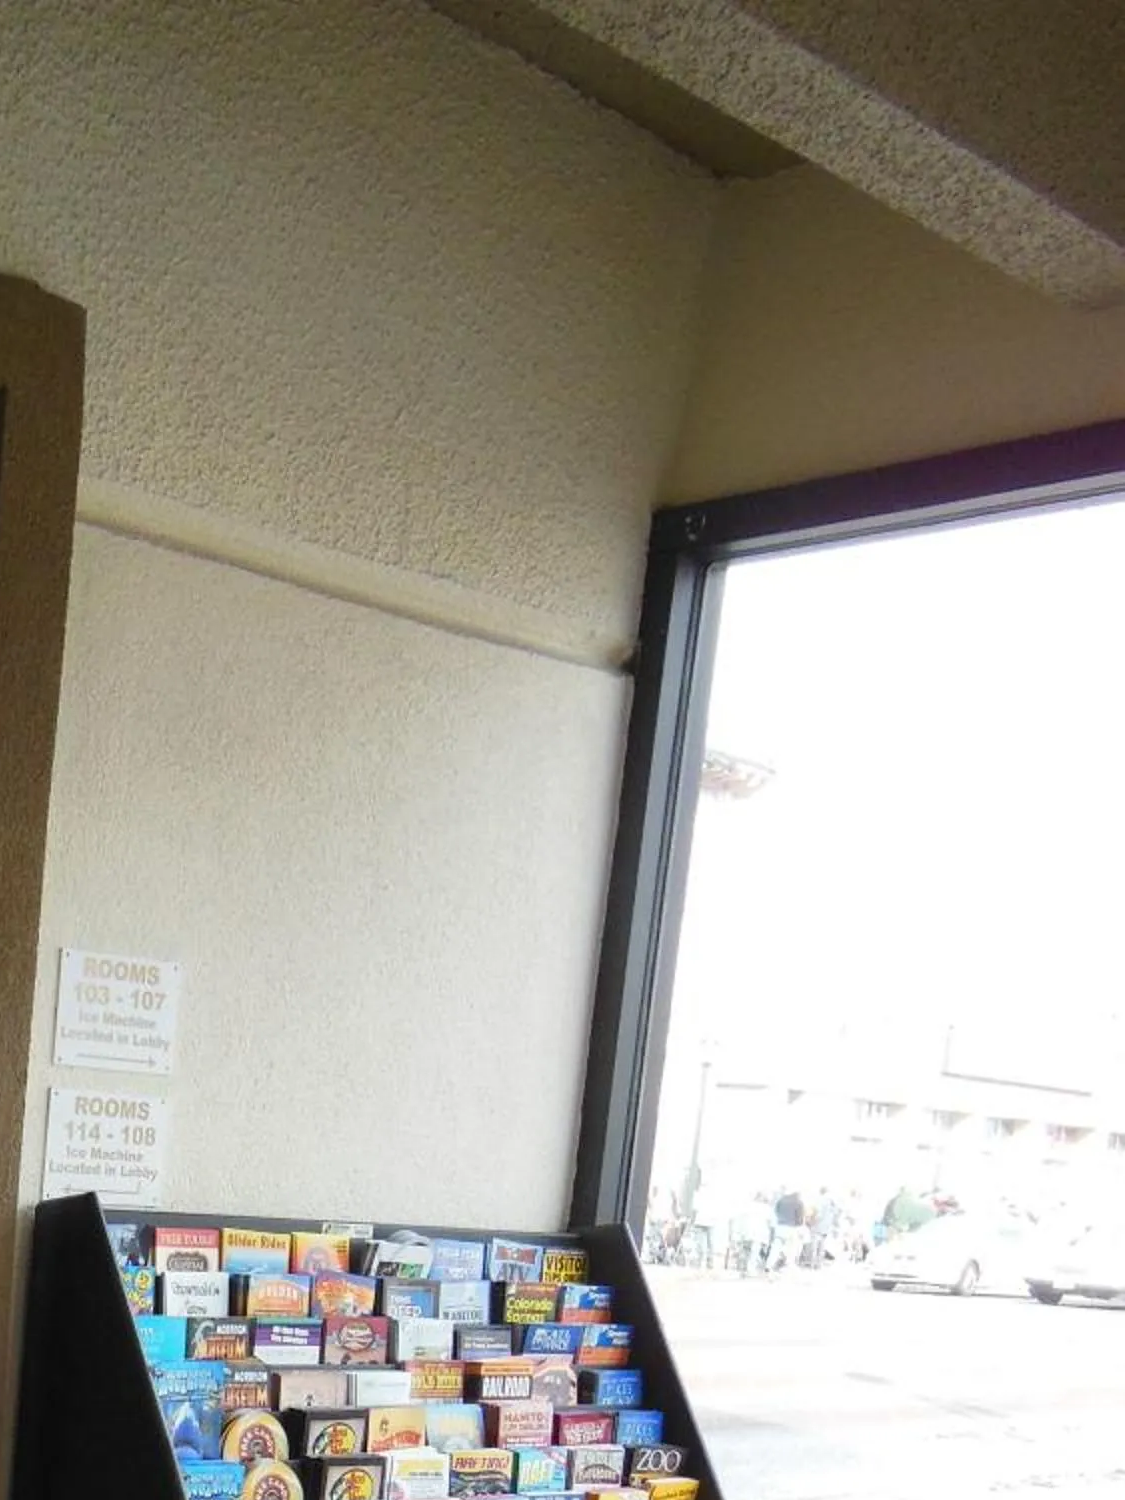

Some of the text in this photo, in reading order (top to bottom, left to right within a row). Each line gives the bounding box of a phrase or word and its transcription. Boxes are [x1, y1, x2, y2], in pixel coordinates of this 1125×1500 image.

[83, 956, 161, 985] ROOMS
[75, 985, 110, 1006] 103
[130, 990, 168, 1011] 107
[78, 1010, 157, 1029] Ice Machine
[60, 1026, 170, 1051] Located in Lobby
[74, 1096, 151, 1121] ROOMS
[65, 1121, 100, 1143] 114
[121, 1126, 156, 1147] 108
[66, 1145, 143, 1163] Ice Machine
[49, 1161, 158, 1183] Located in Lobby
[636, 1446, 683, 1473] ZOO
